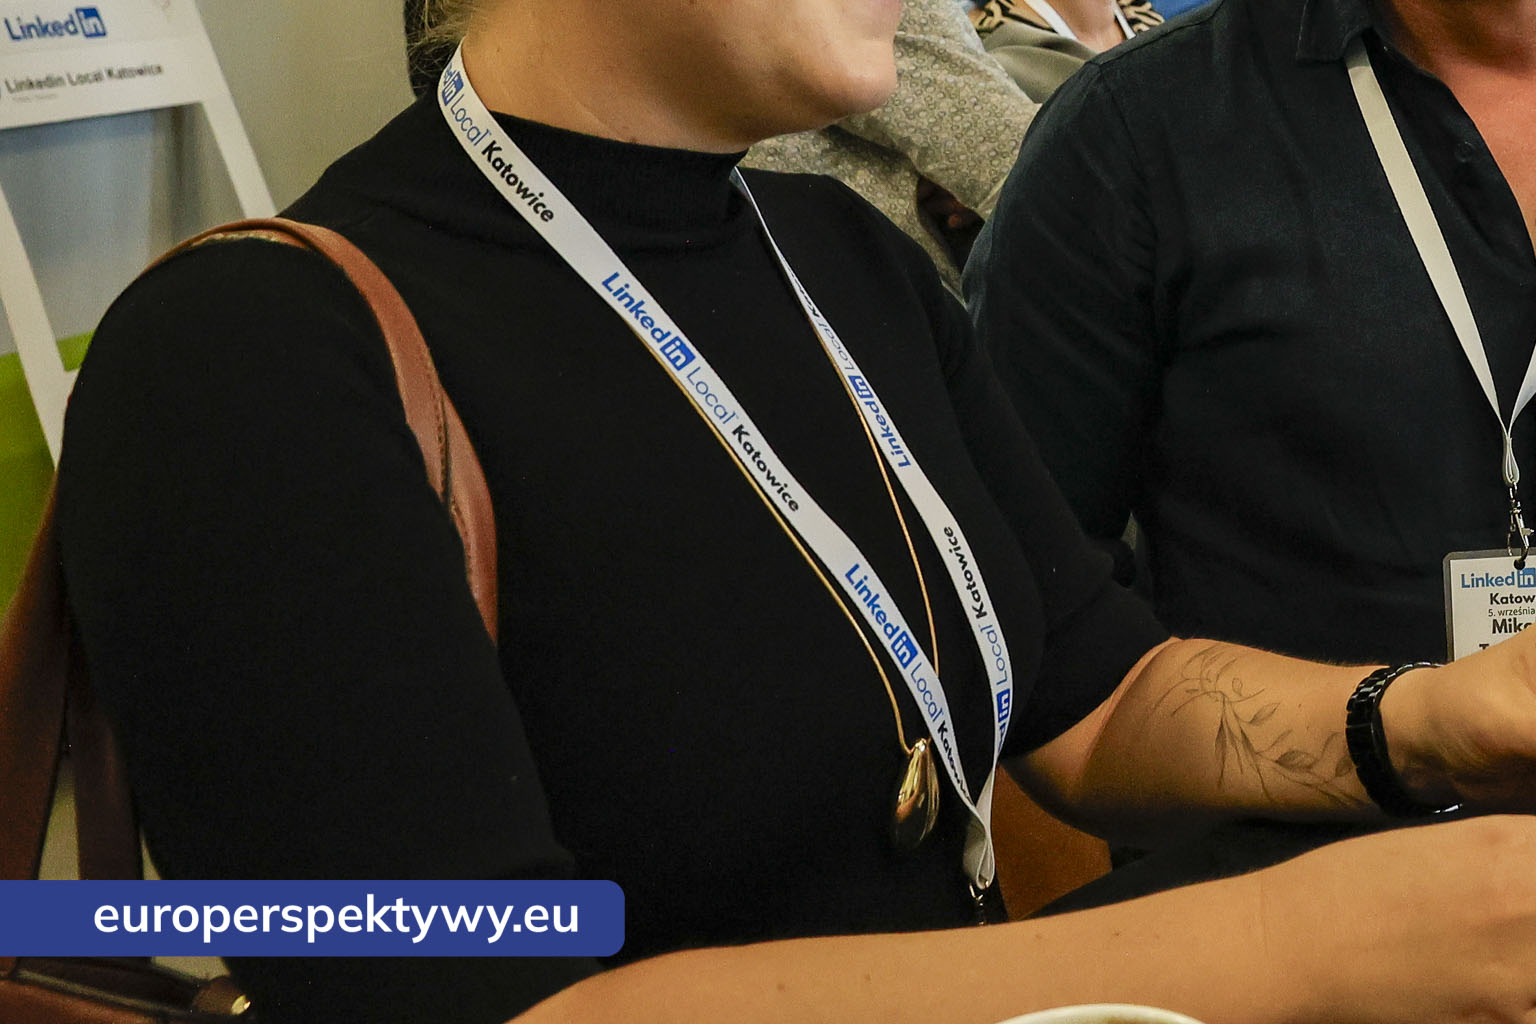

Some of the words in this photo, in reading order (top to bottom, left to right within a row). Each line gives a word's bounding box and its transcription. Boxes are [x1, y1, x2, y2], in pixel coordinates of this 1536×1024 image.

[481, 140, 554, 222] Katowice
[732, 424, 799, 512] Katowice
[943, 526, 987, 619] Katowice
[1488, 609, 1496, 617] 5.
[1498, 607, 1535, 617] września
